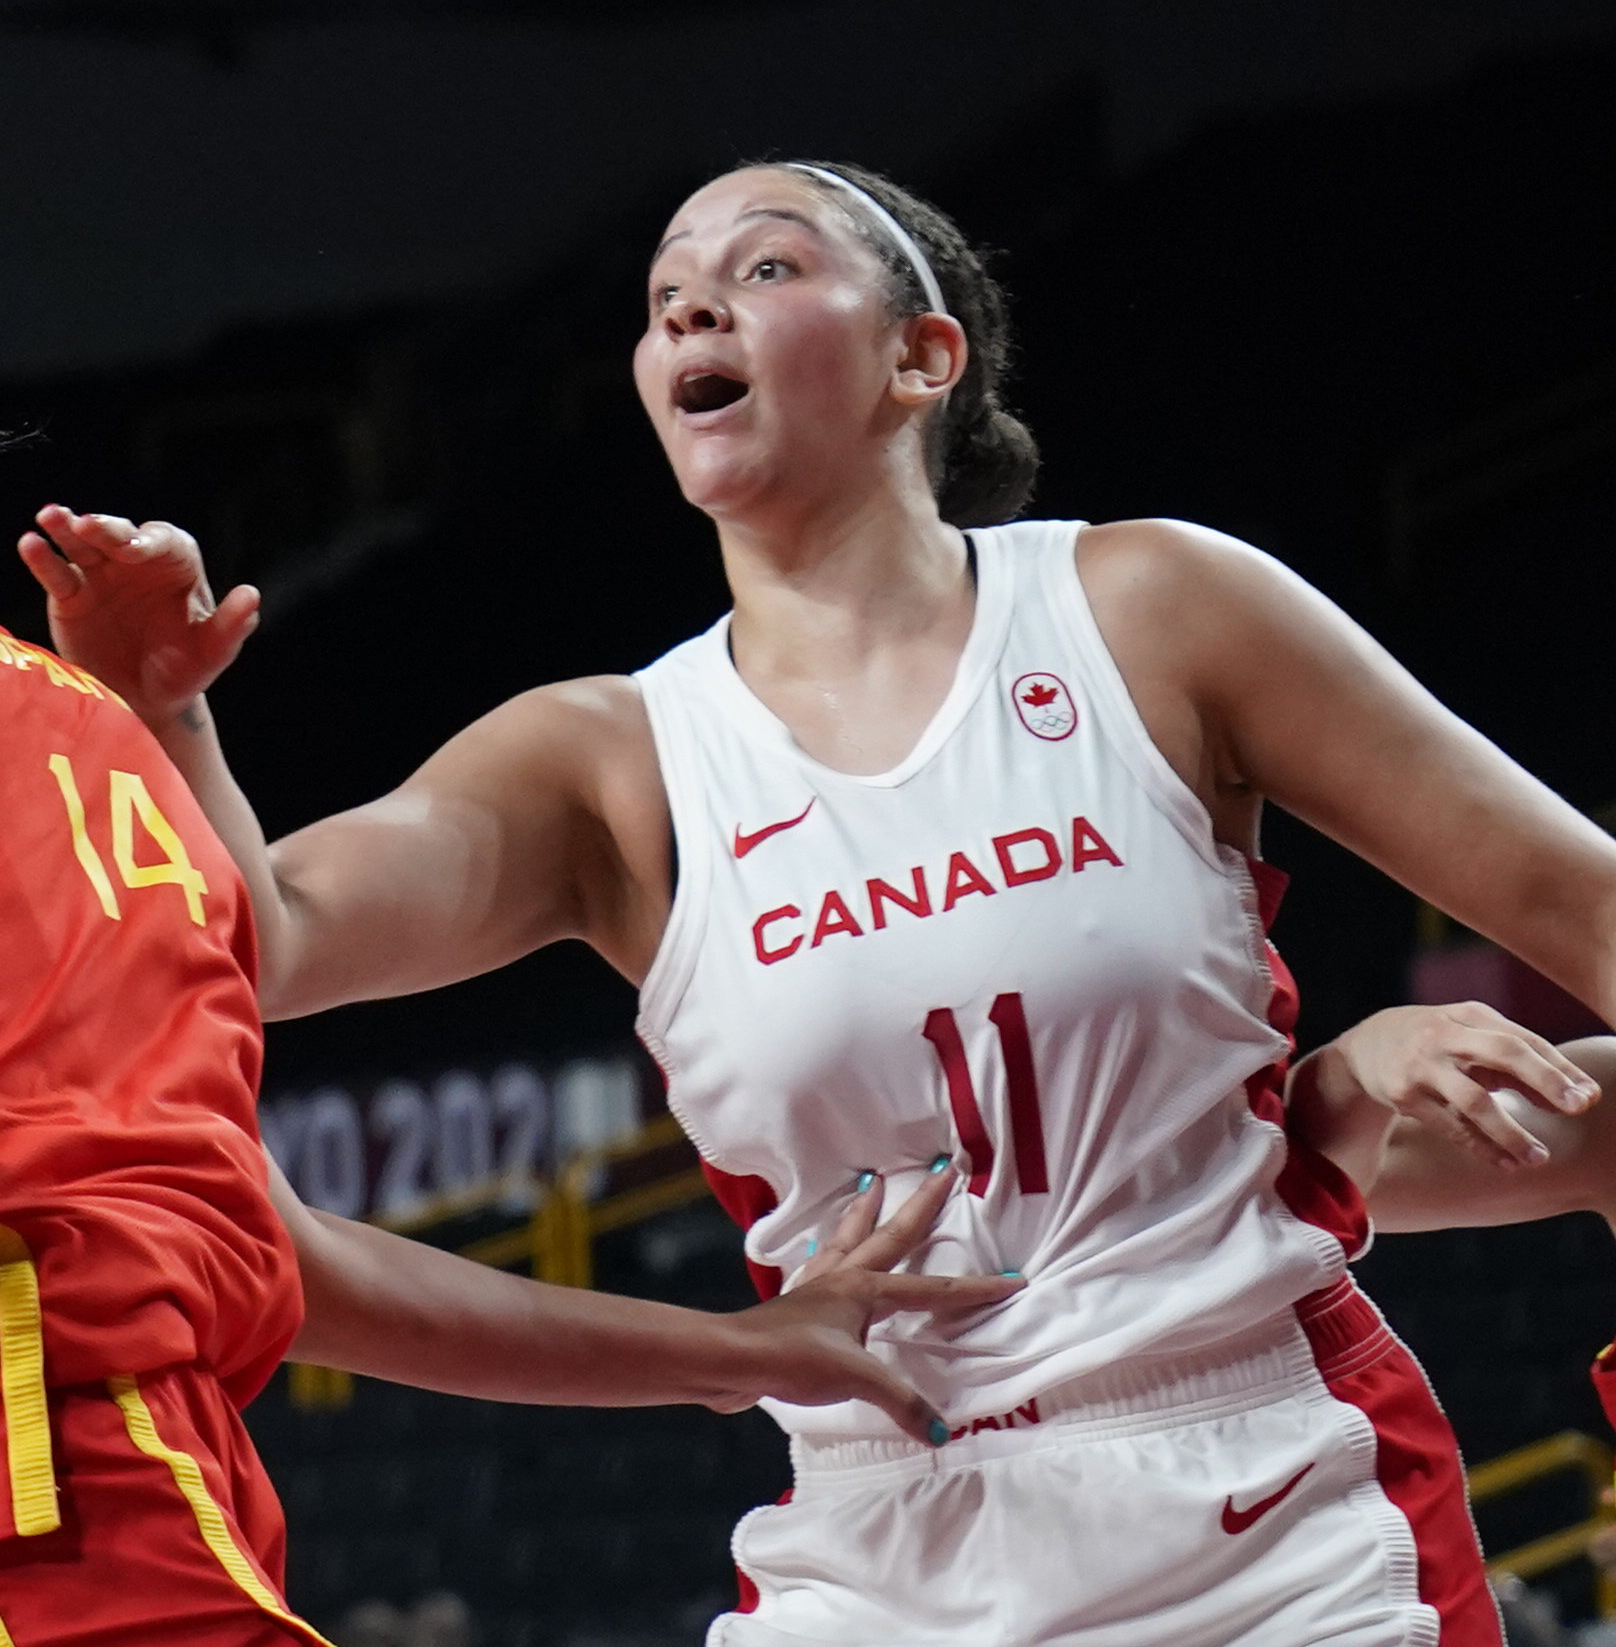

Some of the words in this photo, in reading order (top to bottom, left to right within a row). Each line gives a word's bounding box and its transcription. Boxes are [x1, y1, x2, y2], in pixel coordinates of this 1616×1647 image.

[48, 753, 209, 928] 14
[752, 816, 1125, 966] CANADA
[922, 992, 1049, 1199] 11
